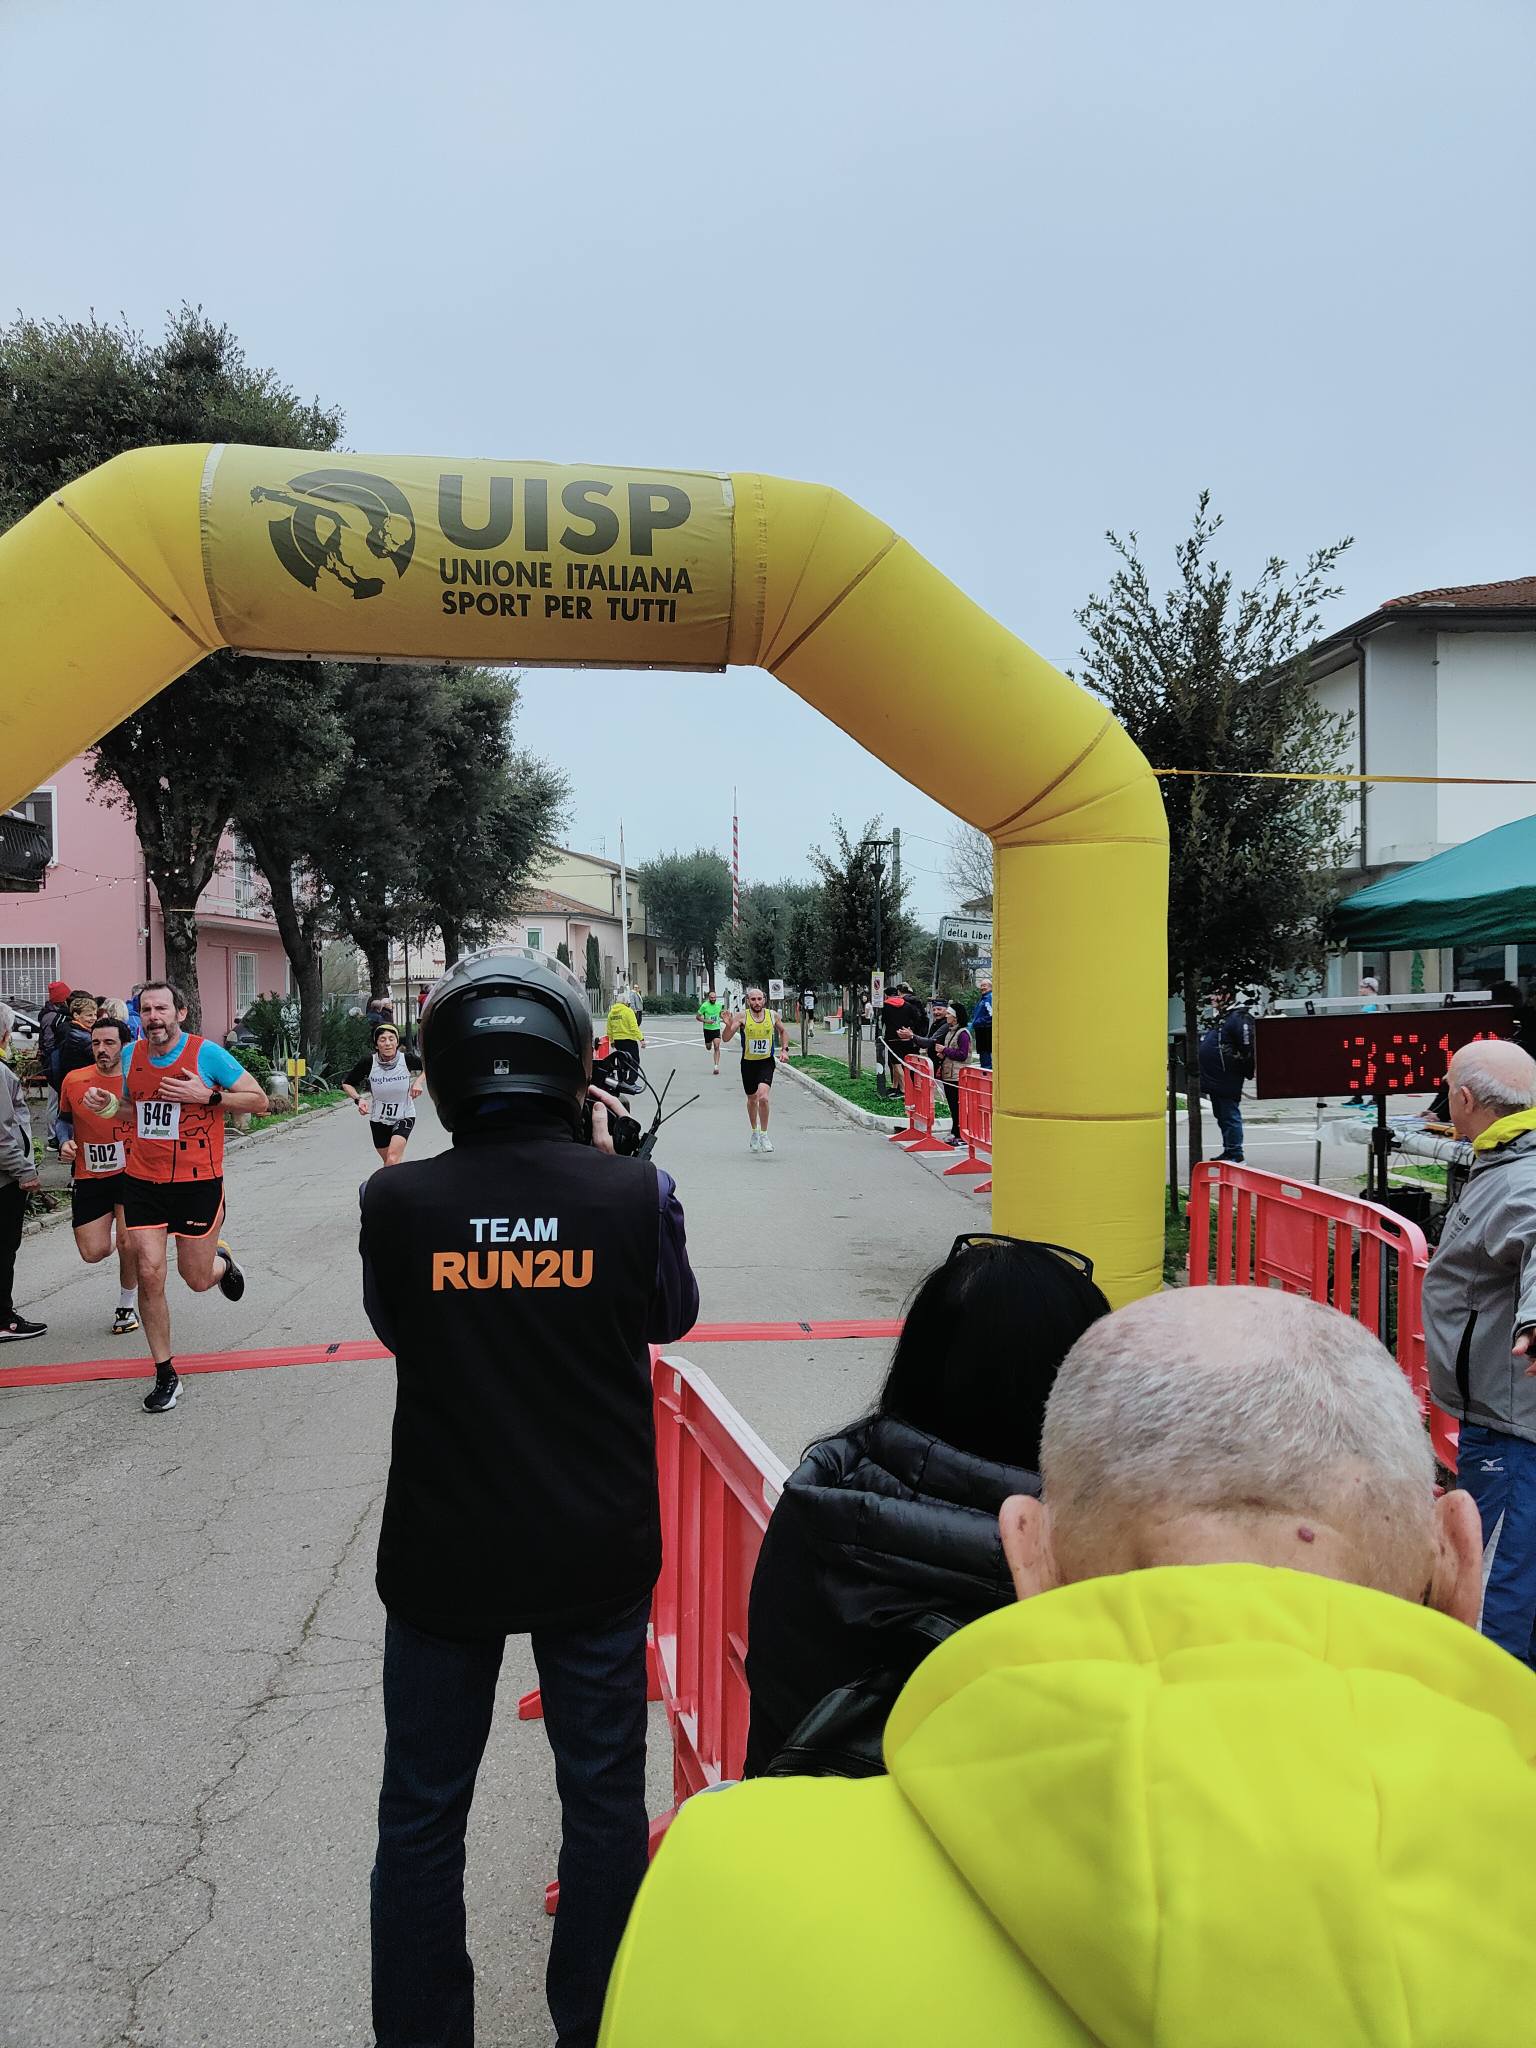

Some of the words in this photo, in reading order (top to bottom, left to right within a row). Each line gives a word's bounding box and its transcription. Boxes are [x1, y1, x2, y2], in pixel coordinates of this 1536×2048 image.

[438, 474, 692, 557] UISP
[439, 558, 552, 588] UNIONE
[566, 563, 694, 594] ITALIANA
[442, 591, 531, 617] SPORT
[544, 596, 593, 620] PER
[607, 598, 677, 623] TUTTI
[947, 928, 968, 938] della
[753, 1039, 767, 1050] 792
[144, 1102, 173, 1127] 646
[381, 1102, 399, 1117] 757
[88, 1143, 118, 1163] 502
[469, 1217, 559, 1243] TEAM
[432, 1249, 594, 1291] RUN2U
